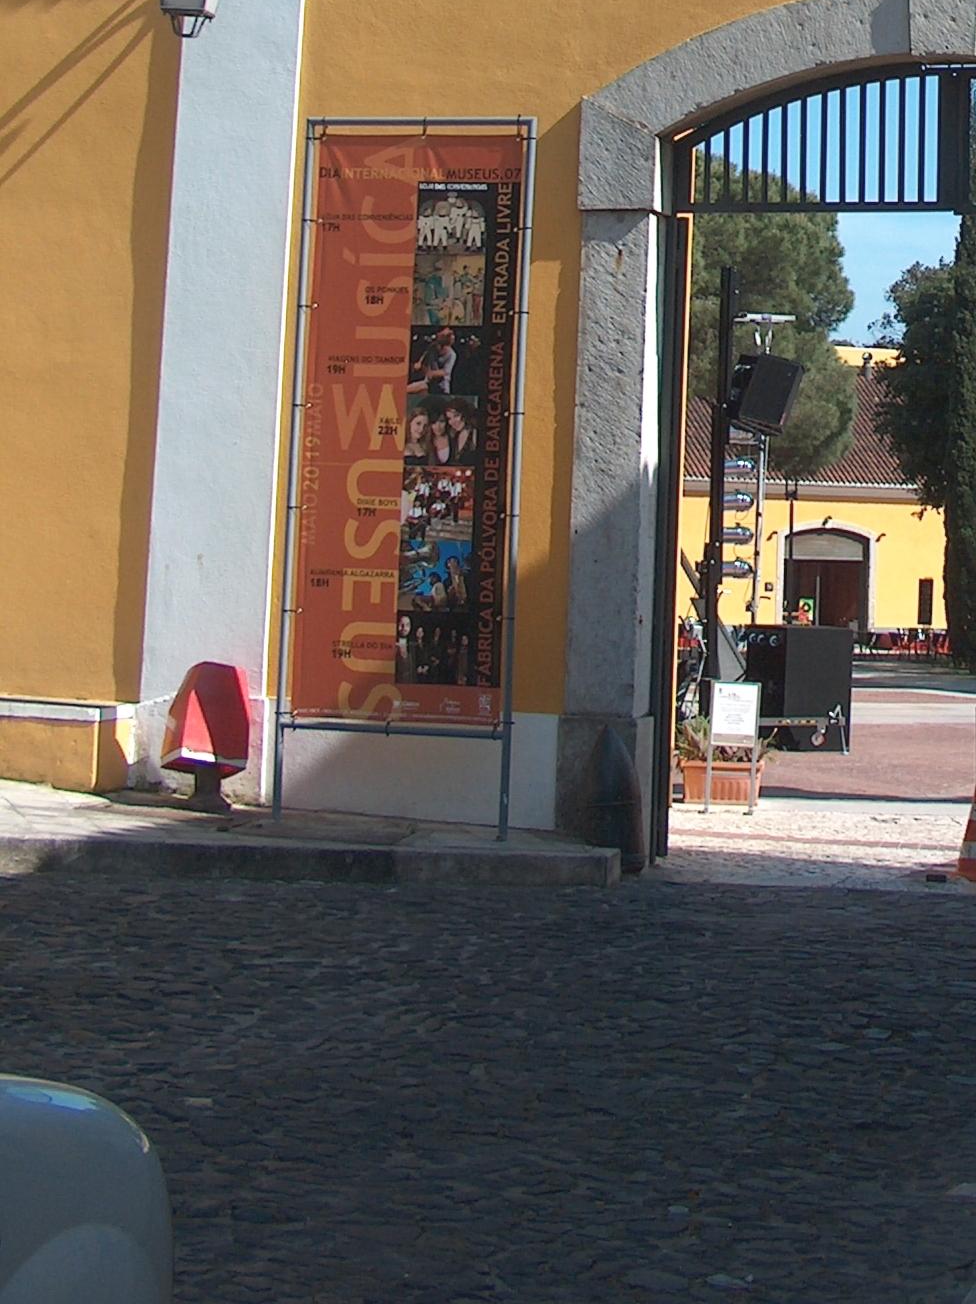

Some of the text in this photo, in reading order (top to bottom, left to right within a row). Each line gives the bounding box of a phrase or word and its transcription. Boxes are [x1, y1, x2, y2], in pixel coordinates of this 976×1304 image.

[319, 168, 341, 180] DIA
[496, 183, 513, 234] LIVRE
[492, 238, 511, 324] ENTRADA
[327, 364, 346, 375] 19H
[486, 341, 505, 451] BARCARENA
[302, 466, 320, 492] 20
[484, 457, 500, 481] DE
[356, 507, 377, 517] 17H
[479, 486, 499, 573] PÓLVORA
[481, 578, 496, 603] DA
[331, 648, 352, 659] 19H
[475, 606, 494, 687] FÁBRICA
